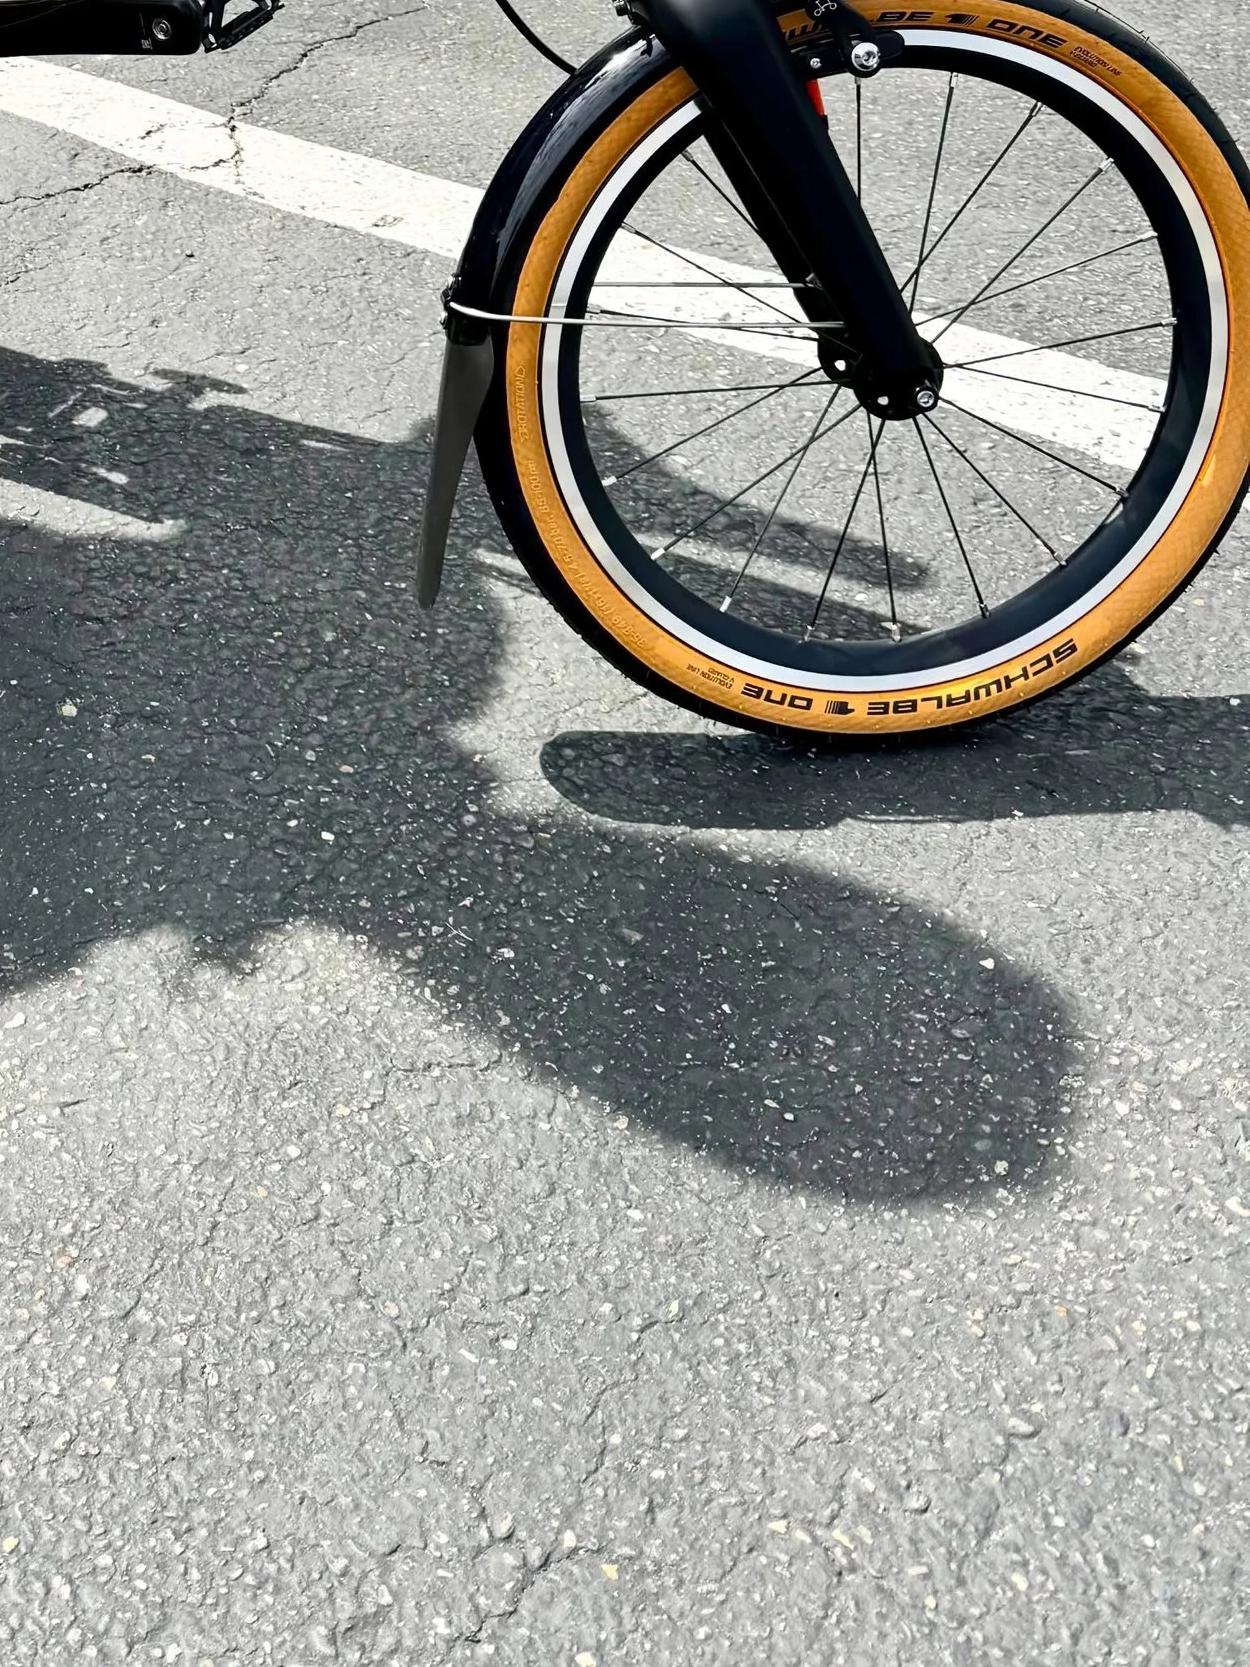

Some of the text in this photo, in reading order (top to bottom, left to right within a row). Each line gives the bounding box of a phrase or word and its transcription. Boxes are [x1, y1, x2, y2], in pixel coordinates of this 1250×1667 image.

[986, 18, 1068, 49] ONE
[867, 637, 1078, 716] SCHWALBE
[741, 682, 813, 711] ONE
